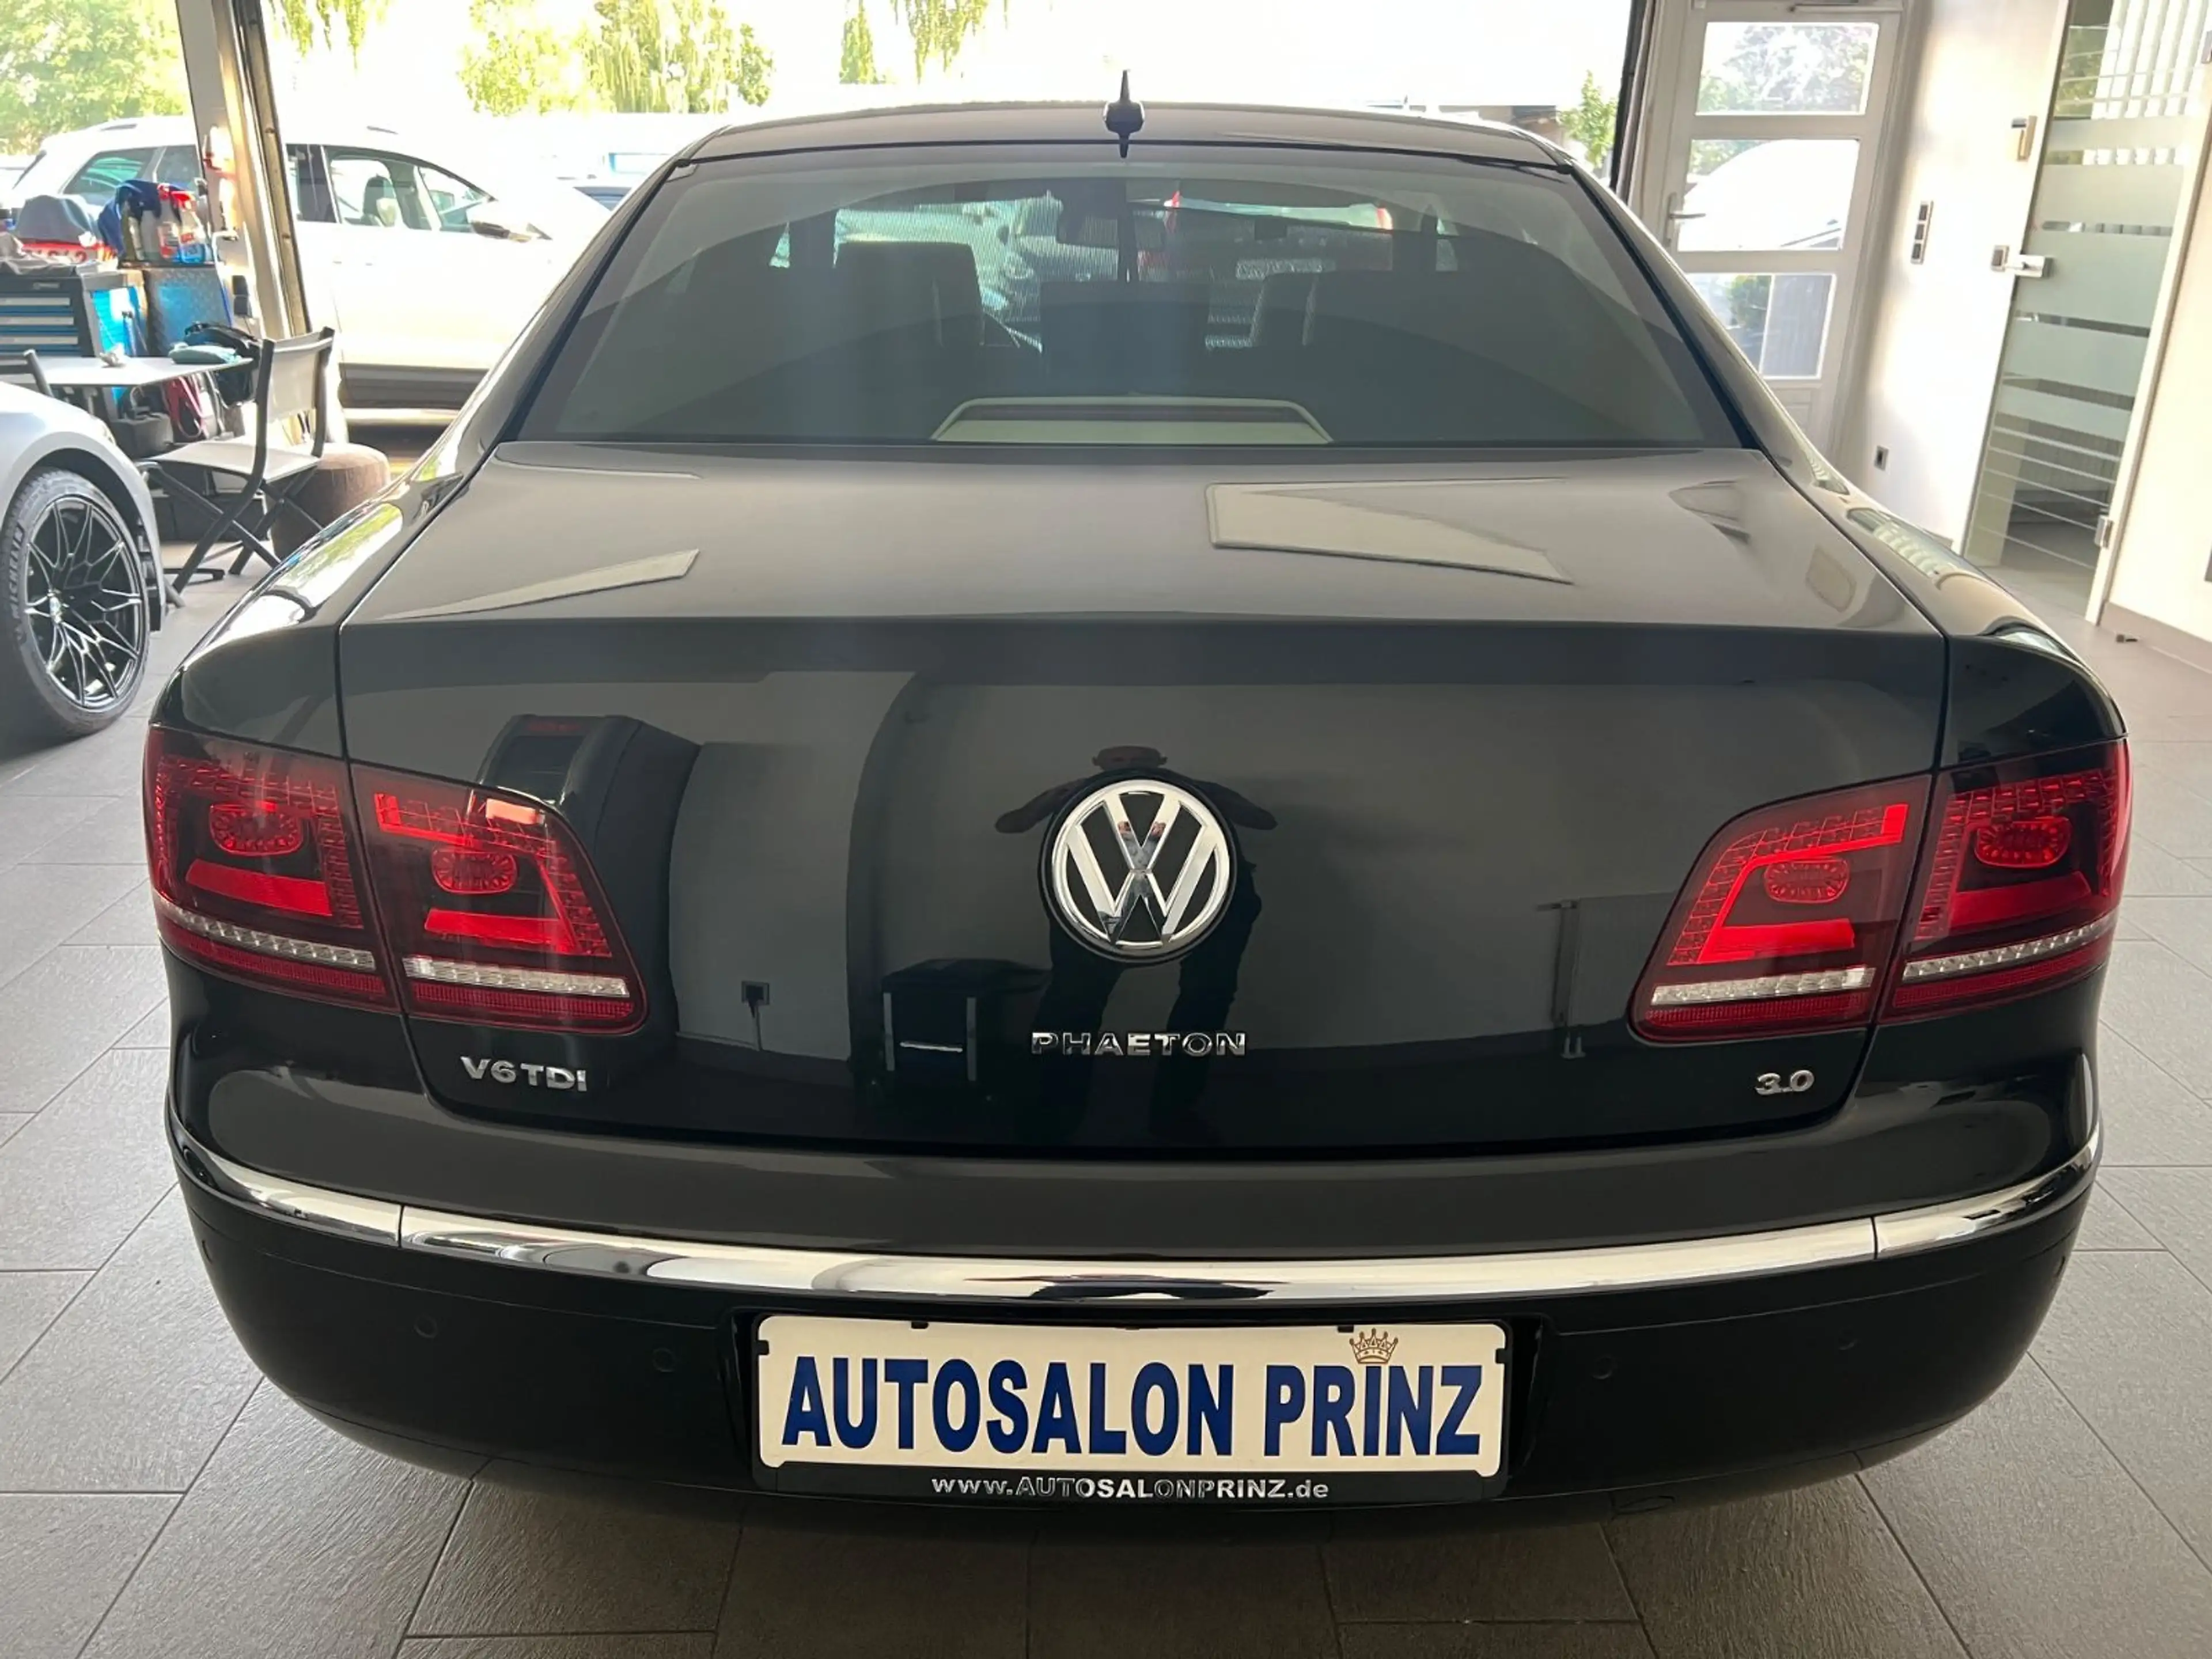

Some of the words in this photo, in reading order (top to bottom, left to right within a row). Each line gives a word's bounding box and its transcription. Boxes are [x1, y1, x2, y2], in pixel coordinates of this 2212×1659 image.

[1031, 1032, 1246, 1056] PHAETON
[460, 1056, 517, 1084] V6
[520, 1063, 588, 1092] TDI
[1755, 1070, 1815, 1095] 3.0
[781, 1355, 1234, 1456] AUTOSALON
[1264, 1364, 1482, 1457] PRINZ
[931, 1476, 1329, 1498] www.AUTOSALONPRINZ.de
